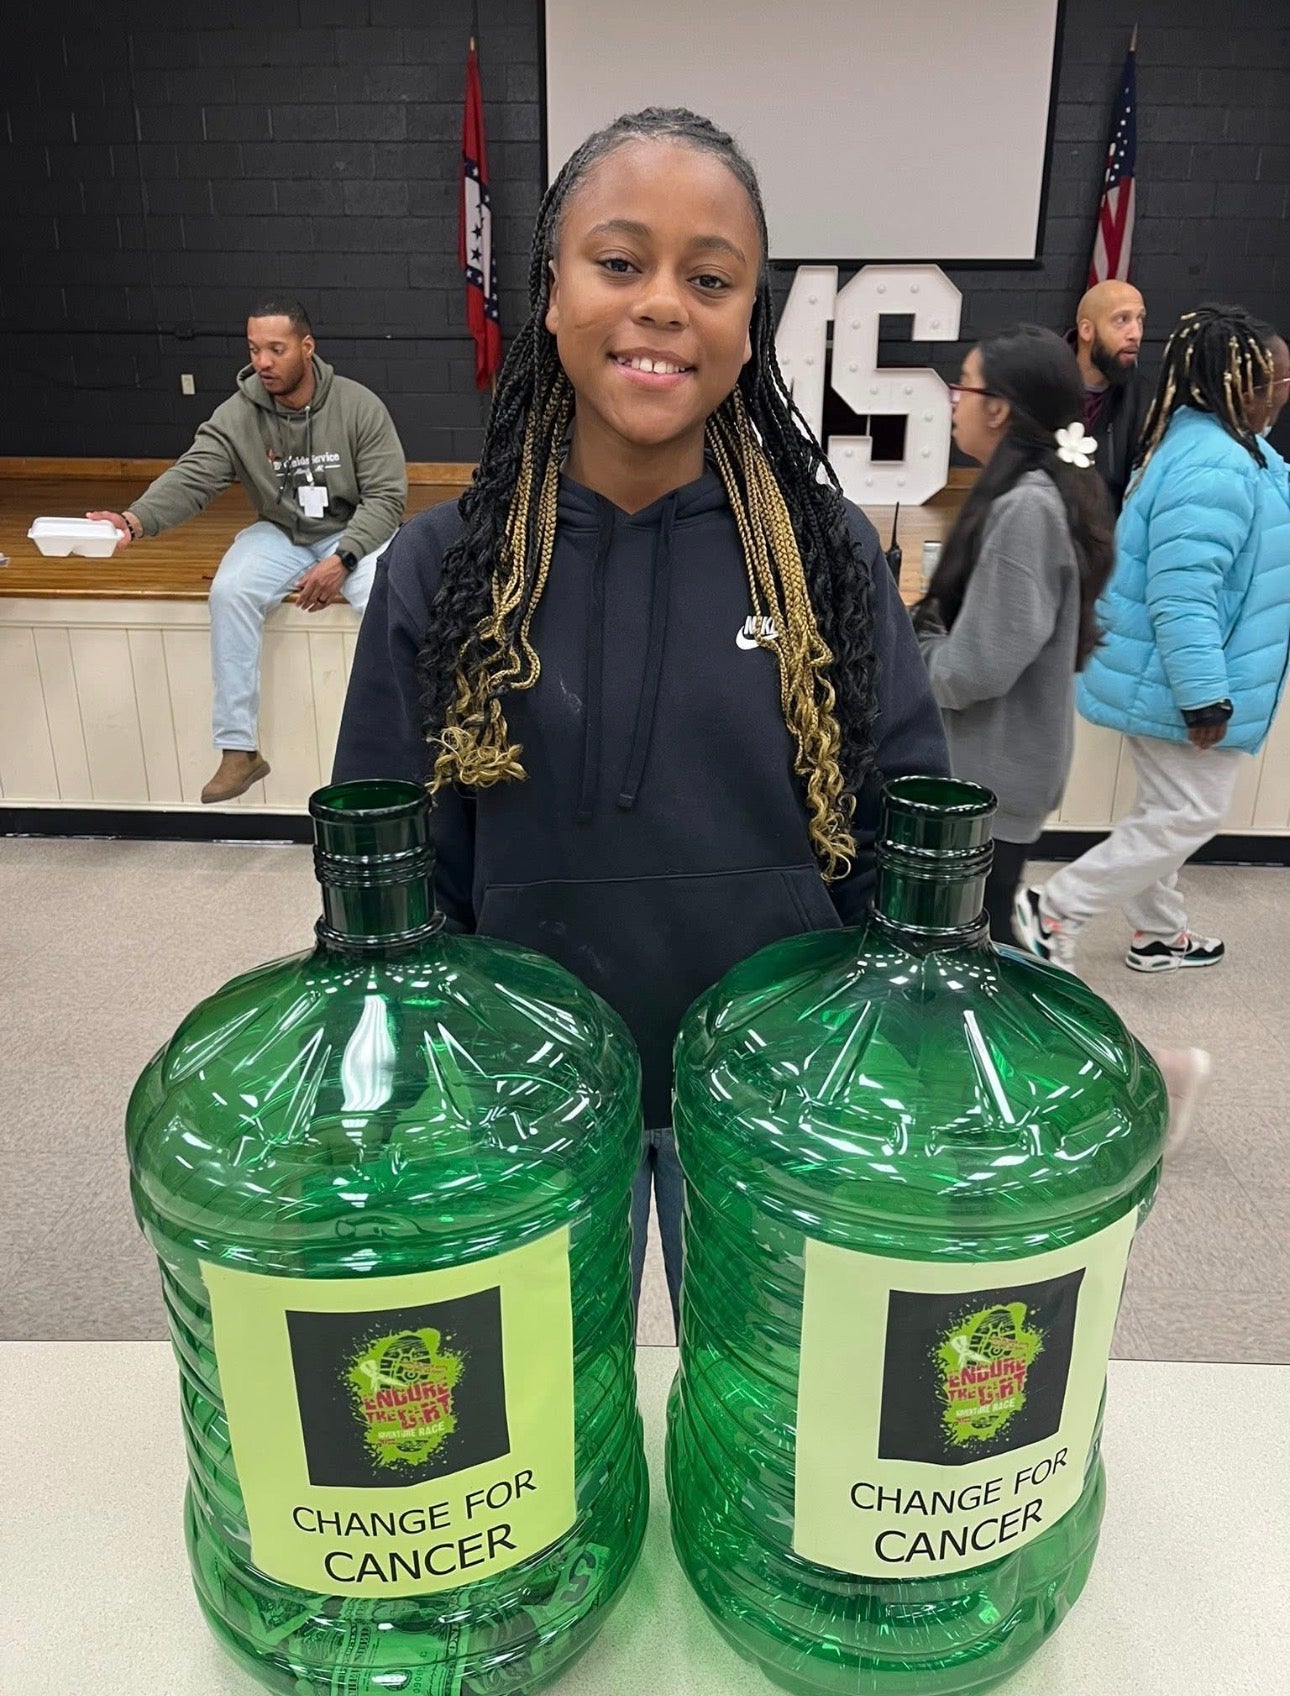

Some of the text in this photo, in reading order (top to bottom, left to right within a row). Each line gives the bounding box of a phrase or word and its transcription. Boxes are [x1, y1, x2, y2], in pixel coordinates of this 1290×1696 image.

[417, 1420, 445, 1437] RACE
[292, 1469, 537, 1537] CHANGE FOR
[850, 1447, 1068, 1516] CHANGE FOR
[324, 1523, 517, 1583] CANCER
[875, 1498, 1043, 1563] CANCER
